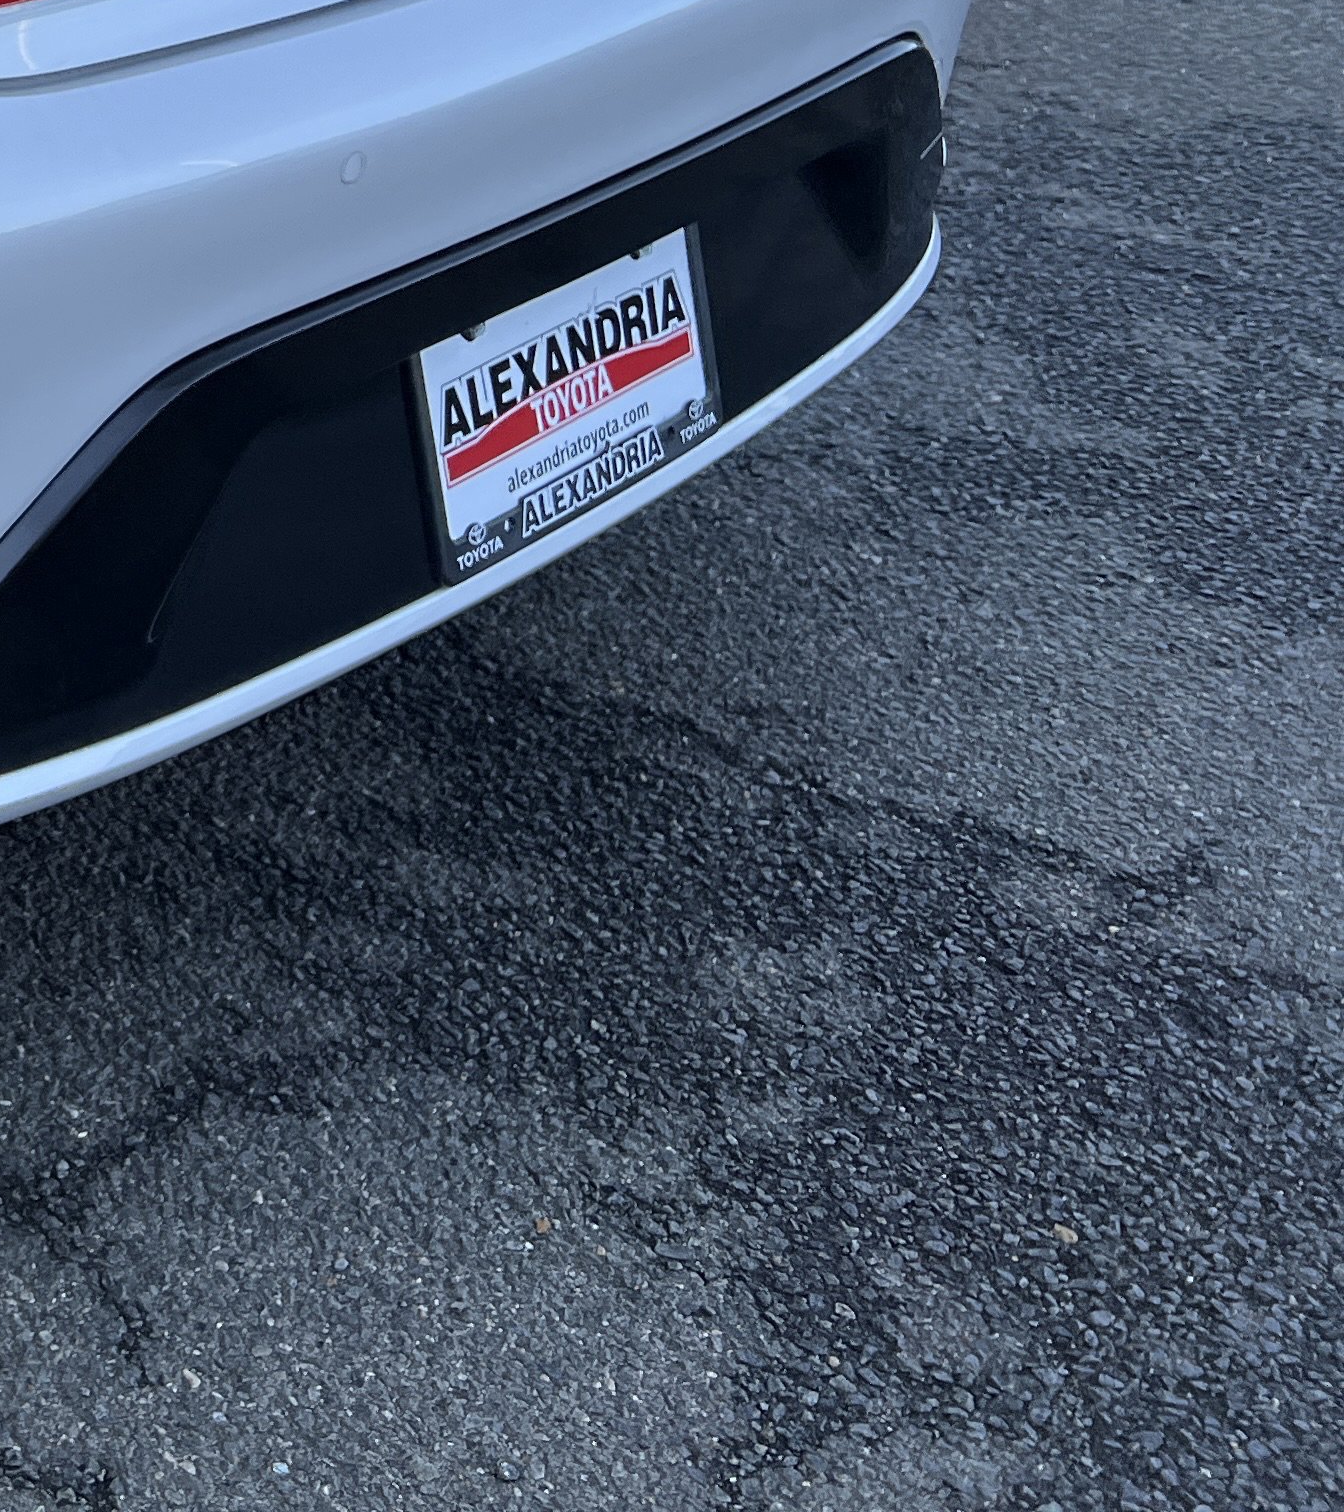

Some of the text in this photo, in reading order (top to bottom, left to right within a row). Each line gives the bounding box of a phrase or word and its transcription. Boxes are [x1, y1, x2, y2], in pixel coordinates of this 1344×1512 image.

[443, 276, 687, 448] ALEXANDRIA
[529, 362, 614, 434] TOYOTA
[507, 399, 650, 493] alexandriatoyota.com
[679, 411, 717, 444] TOYOTA
[521, 426, 665, 538] ALEXANDRIA
[456, 535, 504, 572] TOYOTA
